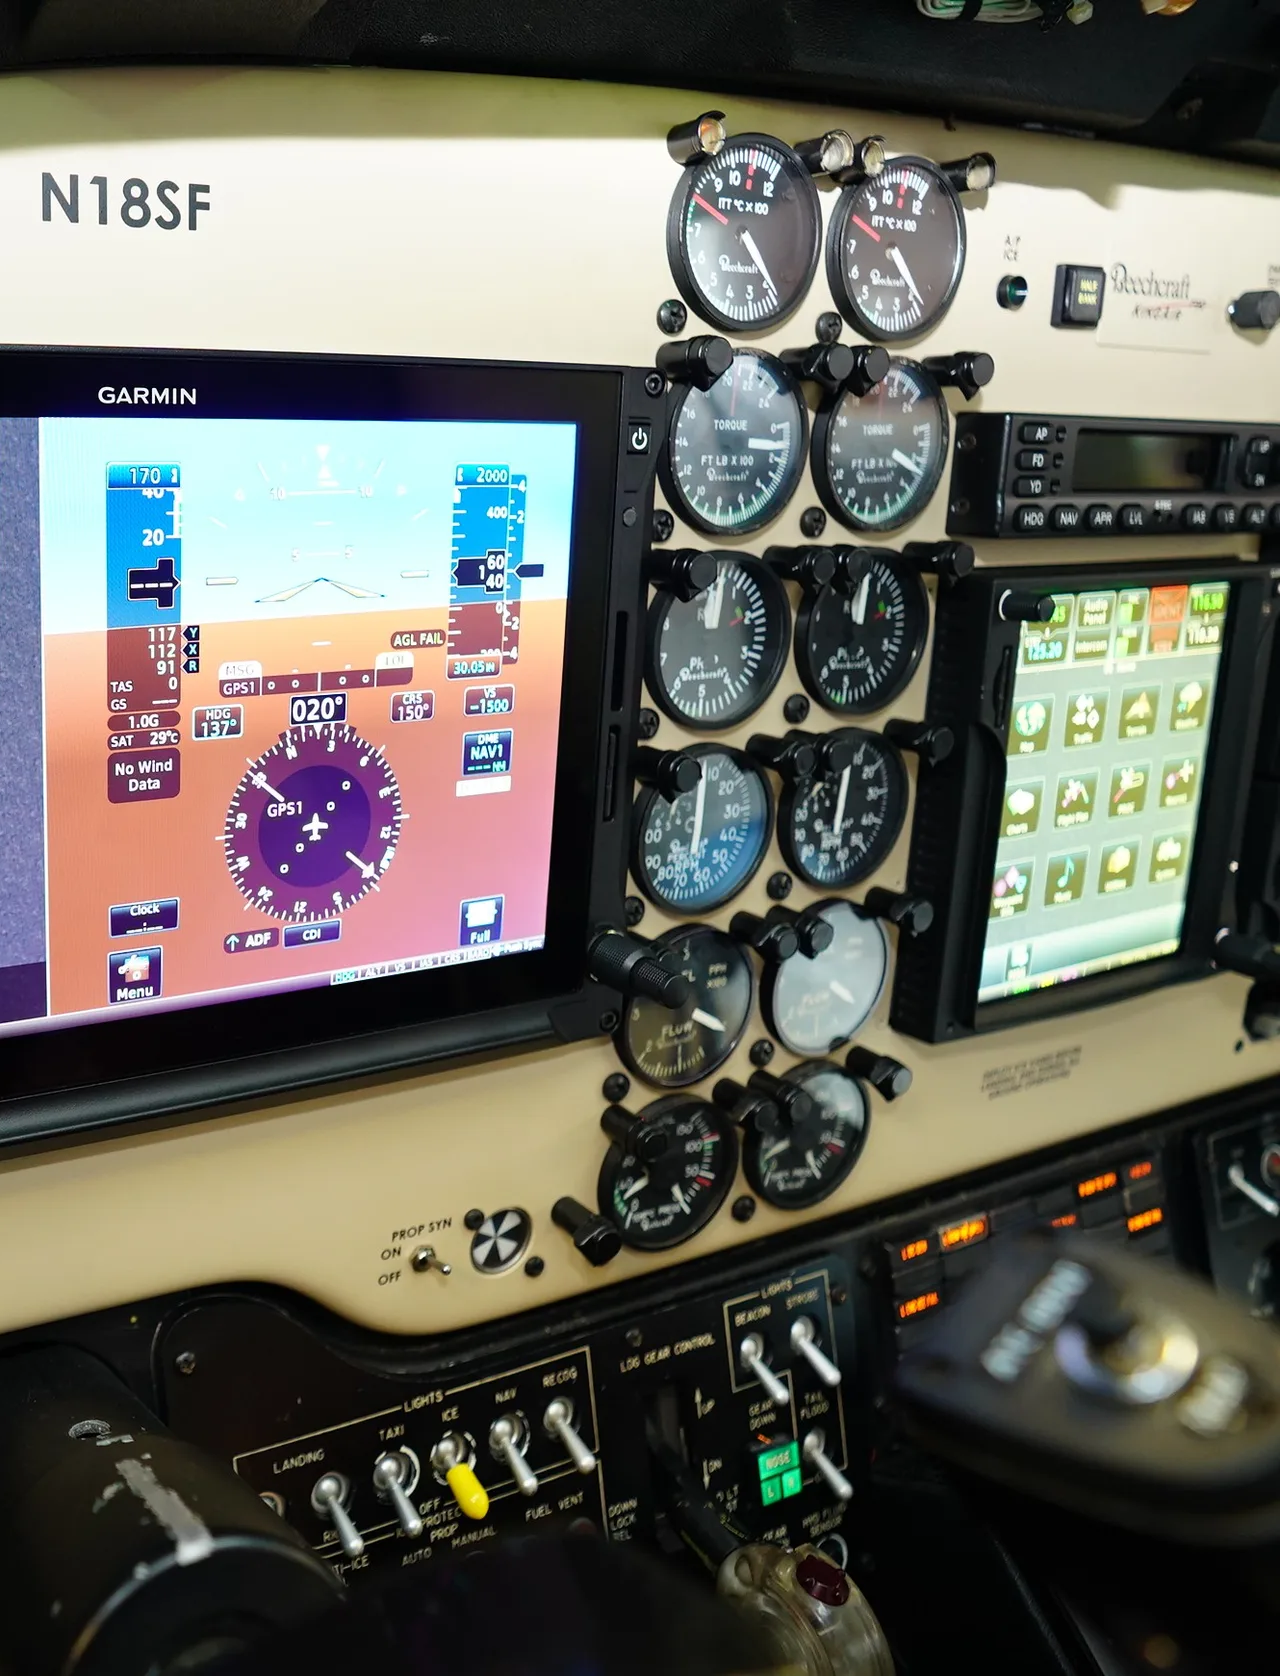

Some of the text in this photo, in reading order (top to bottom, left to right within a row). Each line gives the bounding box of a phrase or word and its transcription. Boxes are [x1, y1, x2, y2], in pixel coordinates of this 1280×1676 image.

[714, 178, 723, 192] 9
[729, 170, 741, 186] 10
[763, 181, 774, 197] 12
[41, 172, 210, 231] N18SF
[754, 202, 769, 216] 100
[718, 254, 759, 274] Beechcraft
[1110, 262, 1190, 299] Beechcraft
[97, 386, 197, 405] GARMIN
[714, 419, 748, 431] TORQUE
[863, 424, 893, 436] TORQUE
[1035, 427, 1048, 440] AP
[701, 455, 754, 466] FT LB 100
[1032, 454, 1044, 467] FD
[129, 467, 162, 485] 170
[476, 466, 508, 483] 2000
[1029, 480, 1042, 493] YD
[486, 506, 508, 519] 400
[1023, 512, 1044, 526] HDG
[1060, 511, 1078, 525] NAV
[1094, 511, 1112, 526] APR
[1129, 512, 1143, 526] LVL
[142, 528, 164, 547] 20
[487, 554, 505, 570] 60
[486, 573, 504, 589] 40
[148, 626, 198, 642] 117 Y
[393, 632, 443, 647] AGL FAIL
[148, 643, 197, 659] 112 X
[156, 660, 197, 675] 91 R
[225, 664, 255, 676] MSG
[110, 681, 133, 693] TAS
[223, 680, 255, 696] GPS1
[484, 688, 496, 698] VS
[110, 699, 127, 710] GS
[403, 692, 423, 705] CRS
[470, 698, 509, 714] -1500
[205, 708, 231, 721] HDG
[292, 696, 343, 722] 020°
[397, 703, 430, 721] 150°
[128, 713, 159, 729] 1.0G
[201, 718, 237, 738] 137°
[110, 735, 134, 747] SAT
[478, 732, 499, 745] DME
[470, 744, 503, 760] NAV1
[115, 758, 173, 776] No Wind
[128, 777, 161, 792] Data
[719, 782, 734, 796] 20
[267, 801, 303, 818] GPS1
[724, 804, 741, 818] 30
[720, 828, 736, 842] 40
[712, 850, 728, 864] 50
[673, 874, 688, 888] 70
[693, 867, 710, 882] 60
[129, 903, 160, 917] Clock
[245, 932, 272, 948] ADF
[302, 928, 321, 941] CDI
[470, 929, 491, 944] Full
[335, 970, 356, 983] HDG
[116, 986, 154, 1002] Menu
[391, 1217, 452, 1243] PROP SYN
[380, 1247, 402, 1261] ON
[378, 1270, 402, 1286] OFF
[734, 1305, 771, 1327] BEACON
[620, 1332, 716, 1373] LDG GEAR CONTROL
[403, 1390, 444, 1413] LIGHTS
[273, 1366, 578, 1475] LANDING TAXI ICE NAV RECOG
[765, 1451, 791, 1470] NOSE
[419, 1498, 441, 1516] OFF
[524, 1491, 584, 1522] FUEL VENT
[608, 1499, 638, 1518] DOWN
[421, 1507, 462, 1528] PROTEC
[610, 1513, 636, 1530] LOCK
[430, 1523, 458, 1543] PROP
[401, 1525, 498, 1567] AUTO MANUAL
